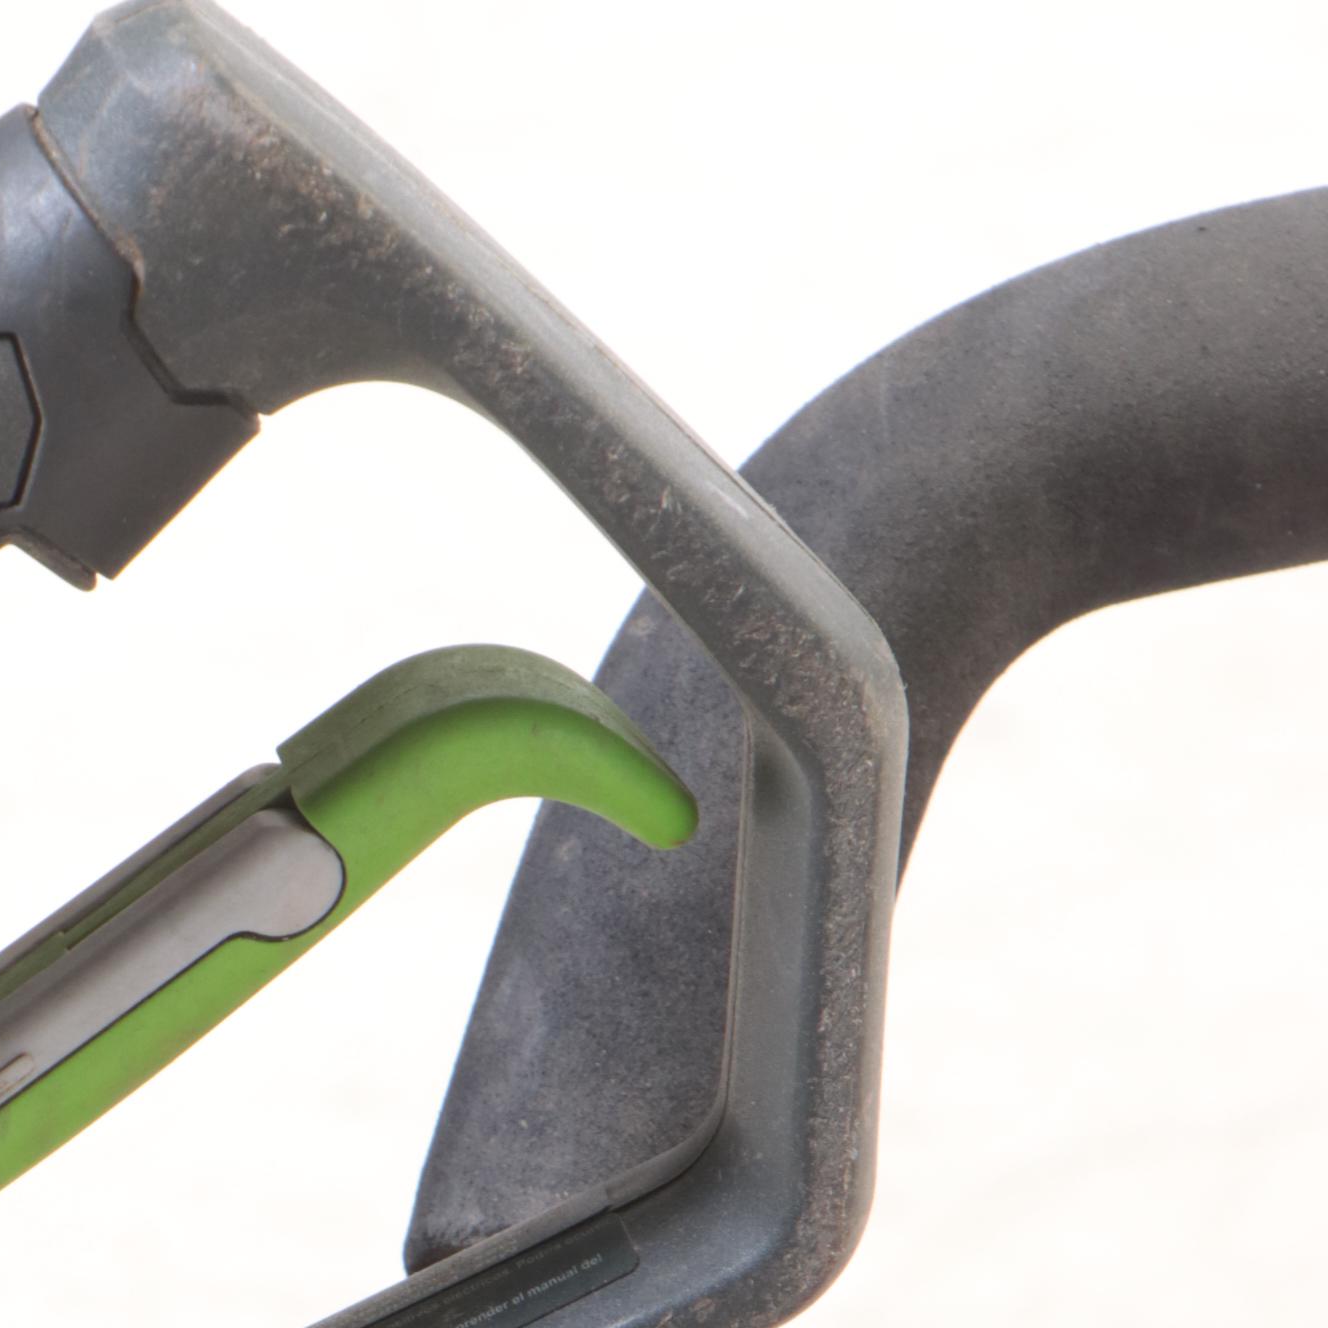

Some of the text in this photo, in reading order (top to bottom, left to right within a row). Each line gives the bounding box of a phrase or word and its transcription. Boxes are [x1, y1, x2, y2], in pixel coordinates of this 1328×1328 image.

[511, 1292, 525, 1306] el
[526, 1266, 579, 1297] manual
[580, 1253, 604, 1270] del
